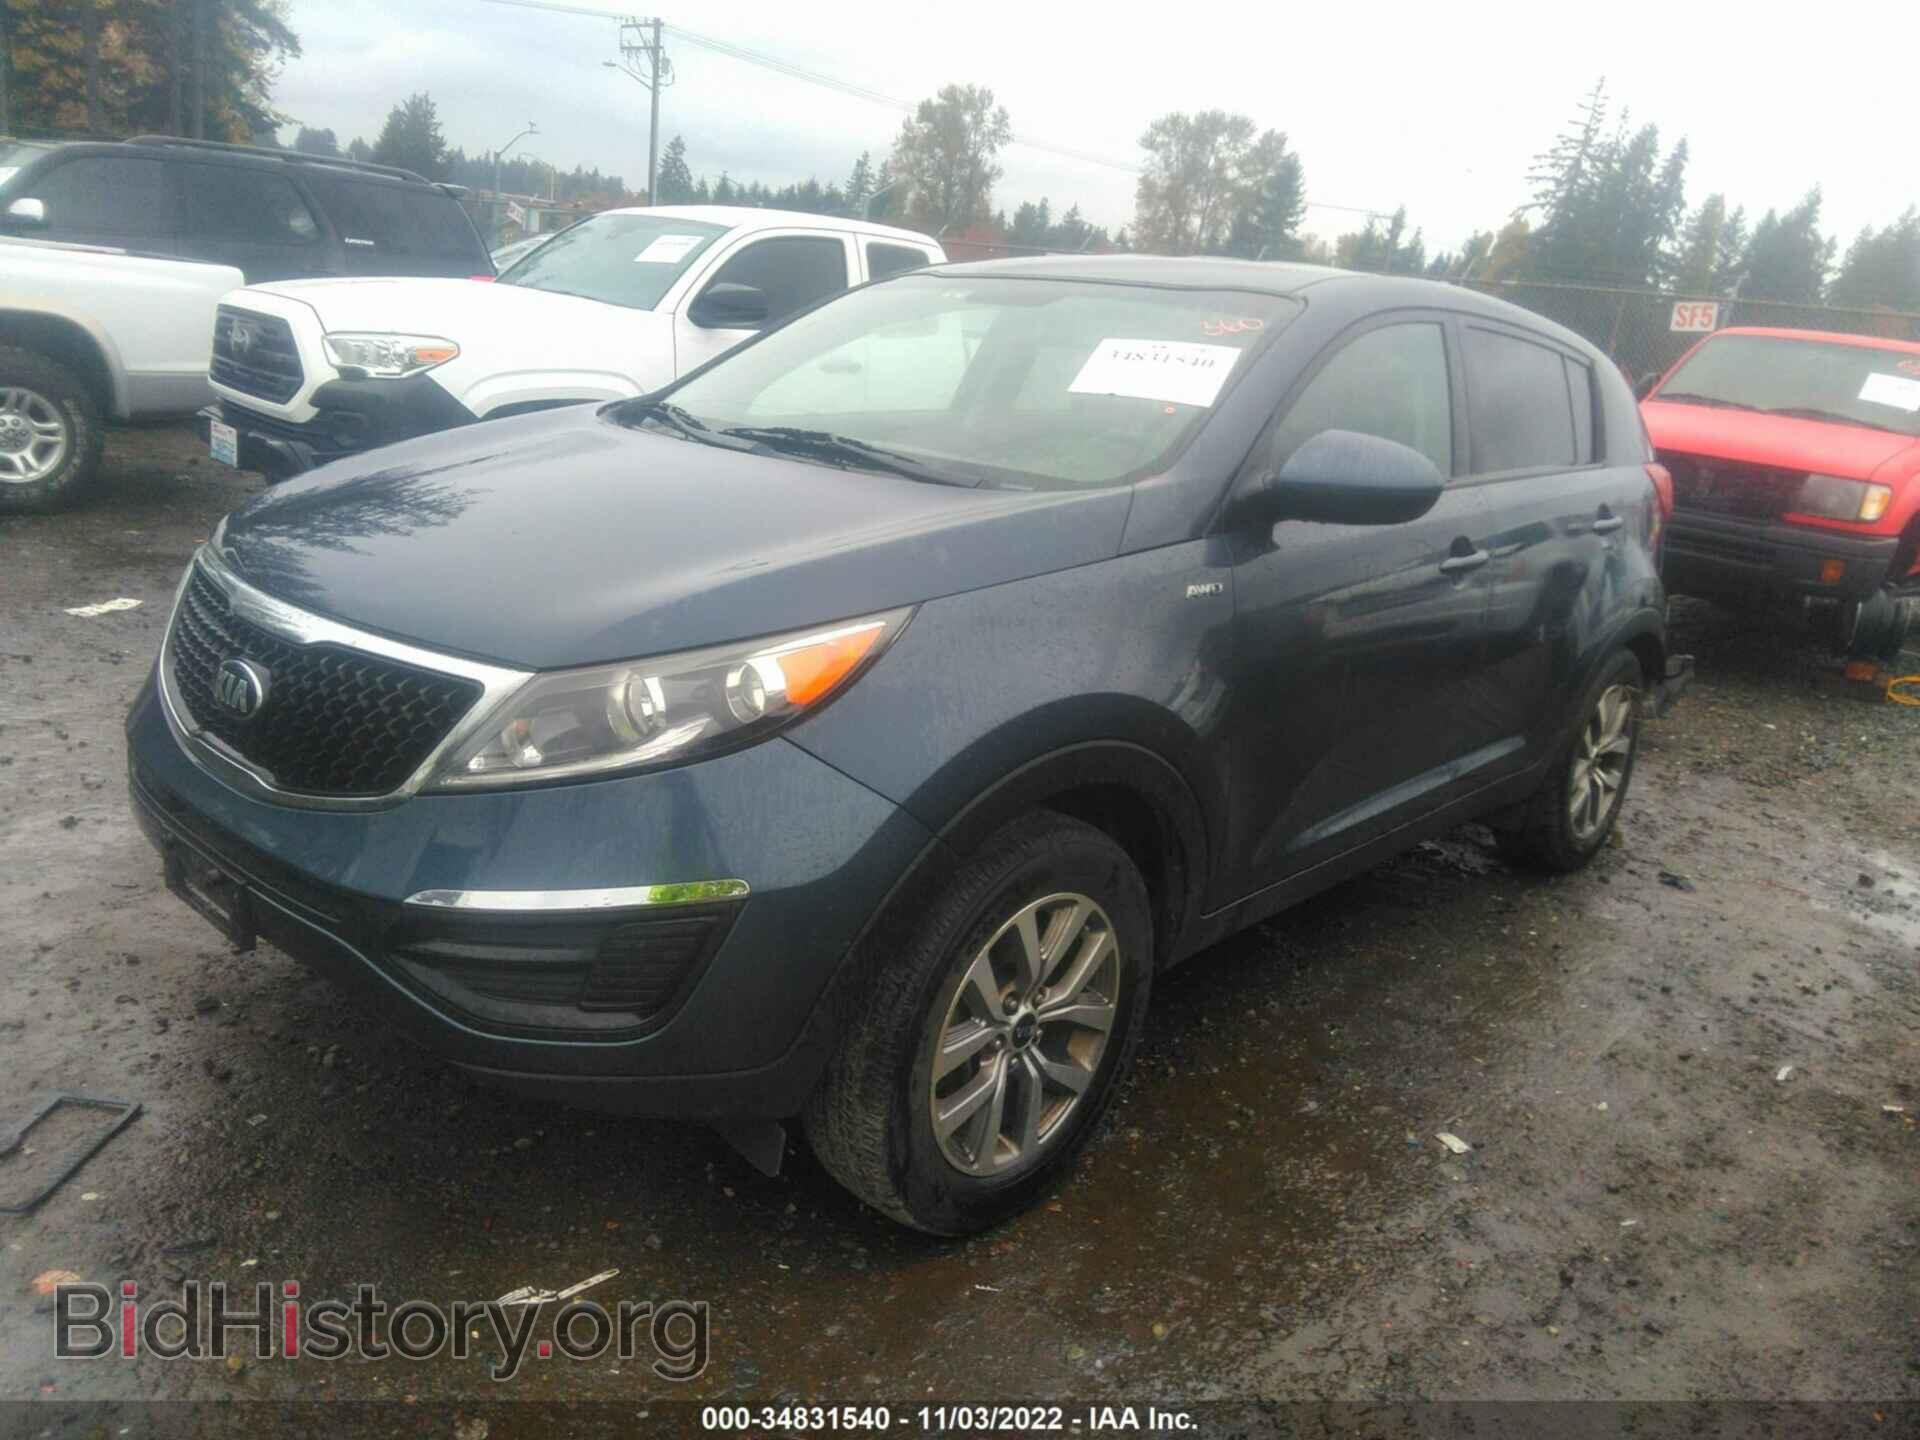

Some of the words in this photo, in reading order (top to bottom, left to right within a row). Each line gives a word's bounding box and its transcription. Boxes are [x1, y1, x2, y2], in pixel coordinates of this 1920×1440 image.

[1674, 303, 1713, 329] SF5
[1184, 583, 1224, 599] AWD
[217, 670, 249, 713] KIA
